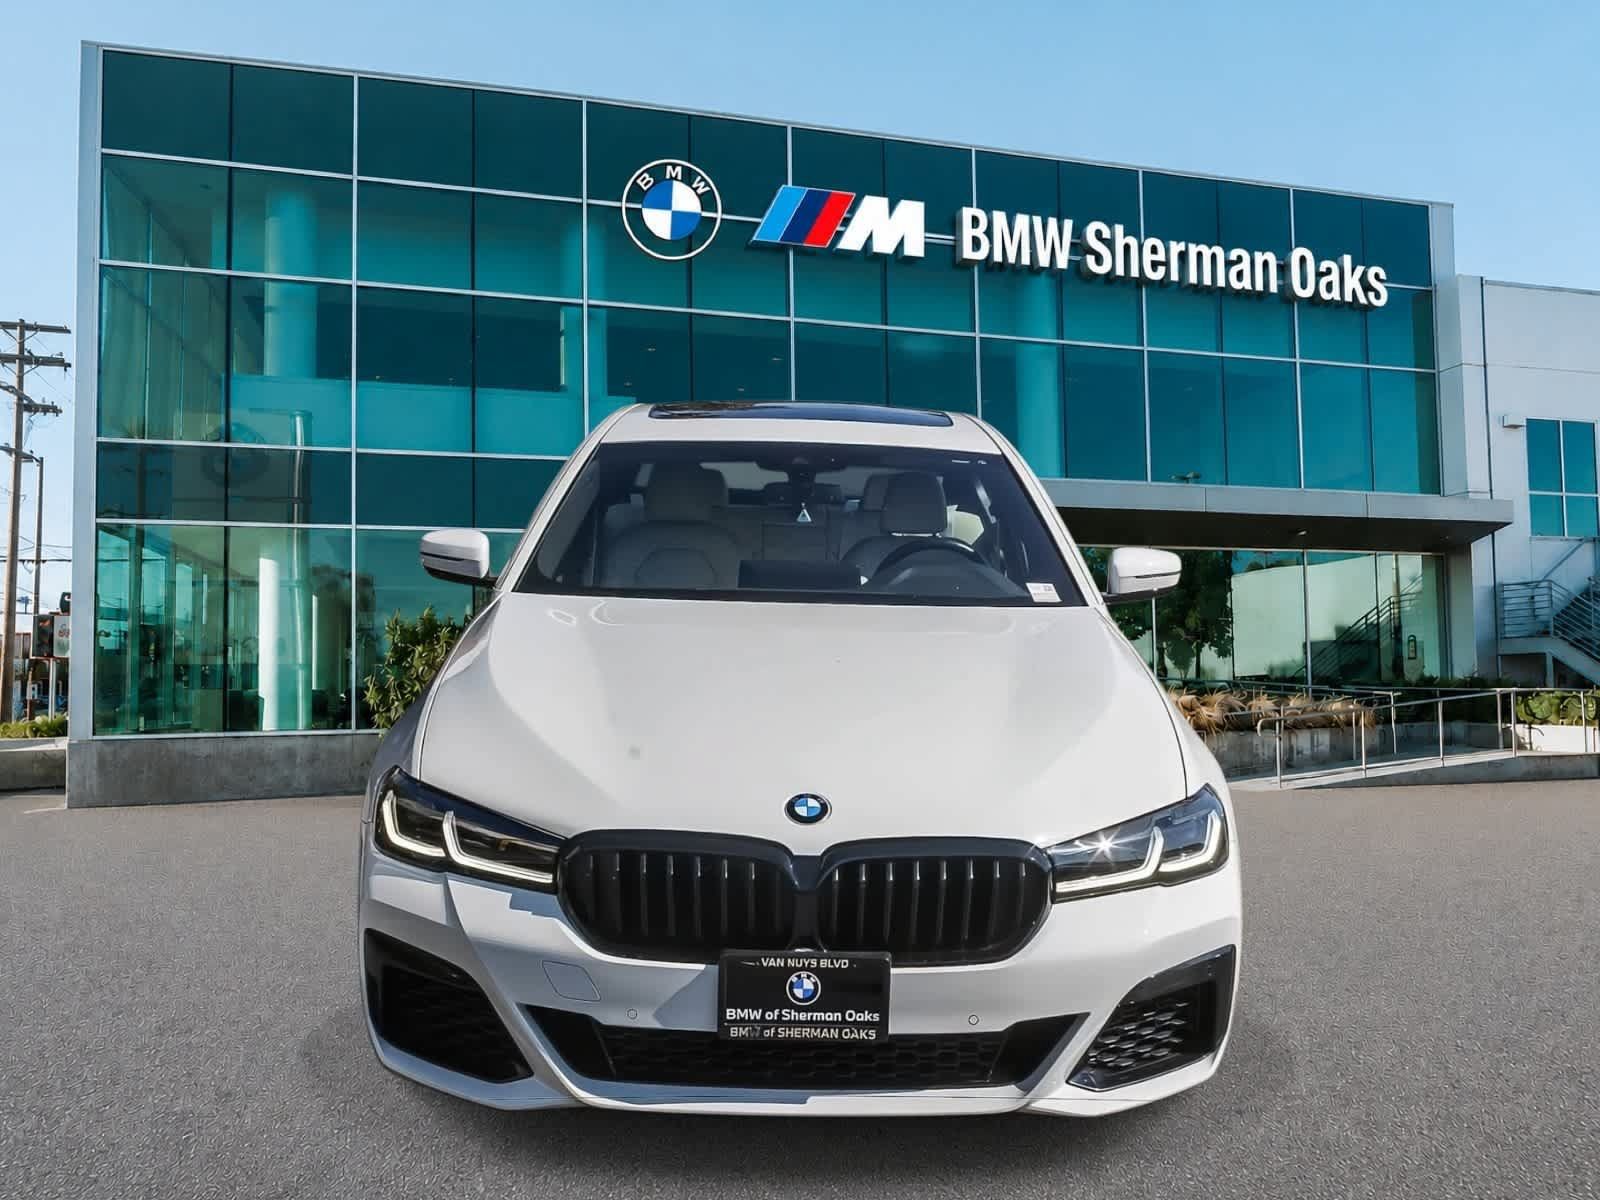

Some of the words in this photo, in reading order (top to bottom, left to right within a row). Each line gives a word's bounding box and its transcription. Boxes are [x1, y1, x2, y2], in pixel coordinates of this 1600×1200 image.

[636, 164, 711, 196] BMW
[835, 195, 925, 258] M
[959, 206, 1073, 269] BMW
[1083, 220, 1278, 294] Sherman
[1287, 247, 1389, 308] Oaks
[761, 957, 785, 968] VAN
[787, 957, 817, 969] NUYS
[819, 958, 849, 969] BLVD
[726, 1008, 762, 1020] BMW
[765, 1009, 780, 1021] of
[781, 1009, 842, 1022] Sherman
[845, 1010, 880, 1022] Oaks
[763, 1027, 776, 1038] of
[777, 1027, 839, 1039] SHERMAN
[841, 1028, 877, 1040] OAKS
